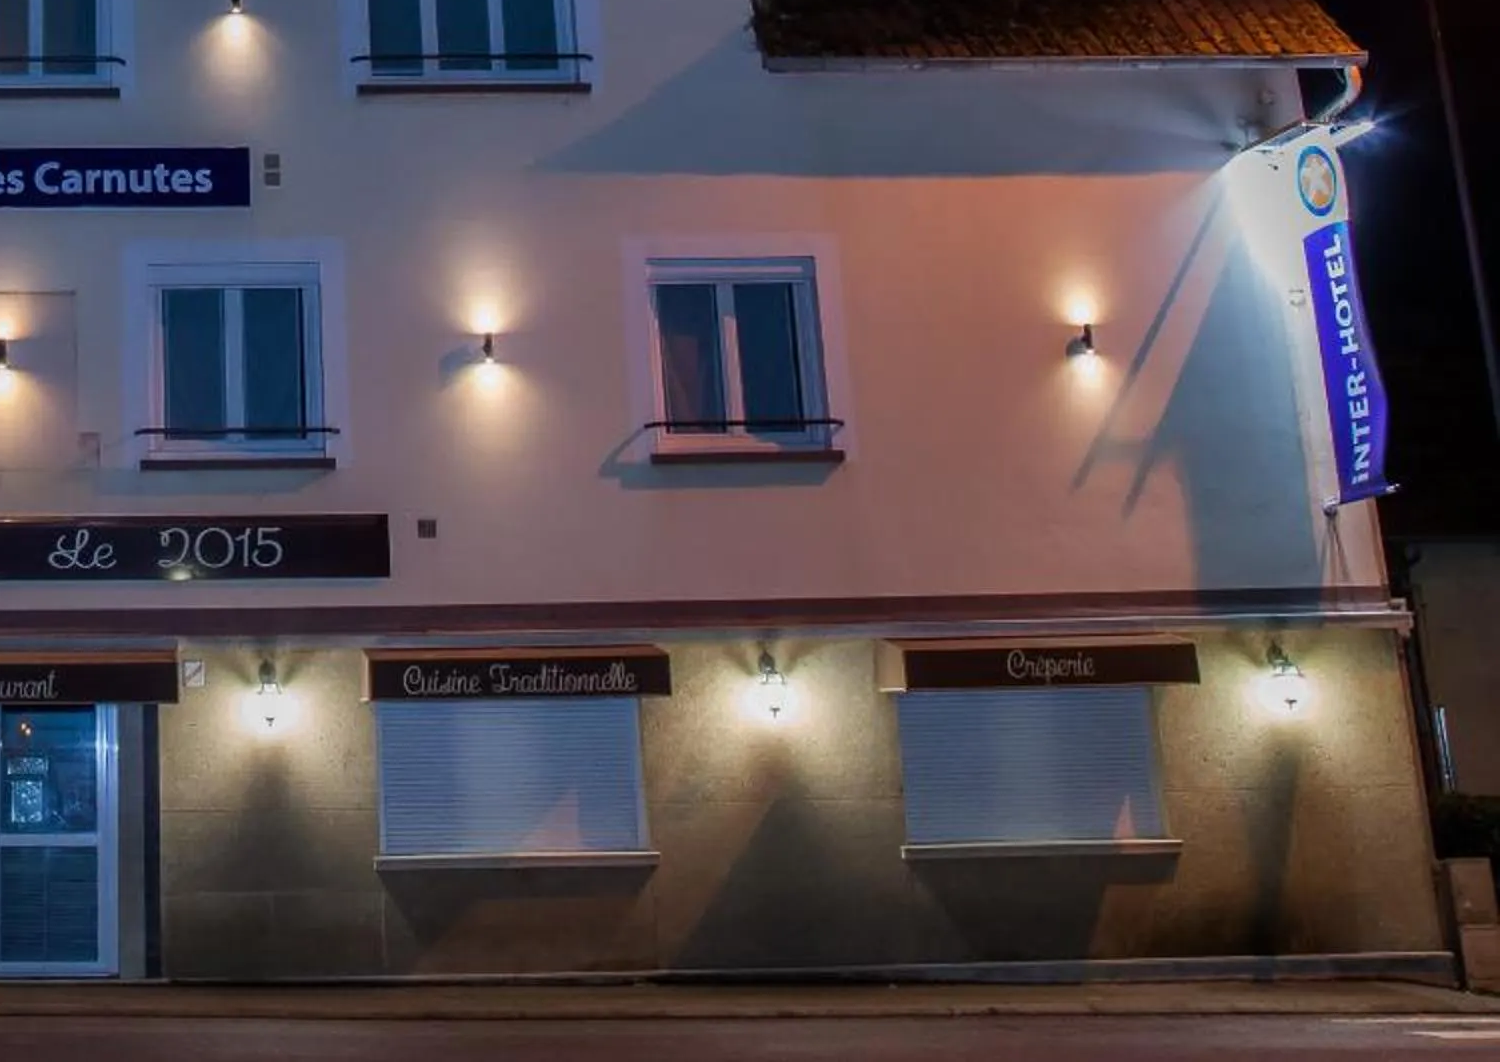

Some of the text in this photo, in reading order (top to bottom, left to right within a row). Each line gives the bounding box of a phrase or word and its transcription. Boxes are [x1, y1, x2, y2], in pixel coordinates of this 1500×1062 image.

[34, 161, 213, 195] Carnutes
[48, 528, 117, 570] Le
[158, 526, 283, 570] 2015
[403, 662, 638, 696] Cuisine Traditionnelle
